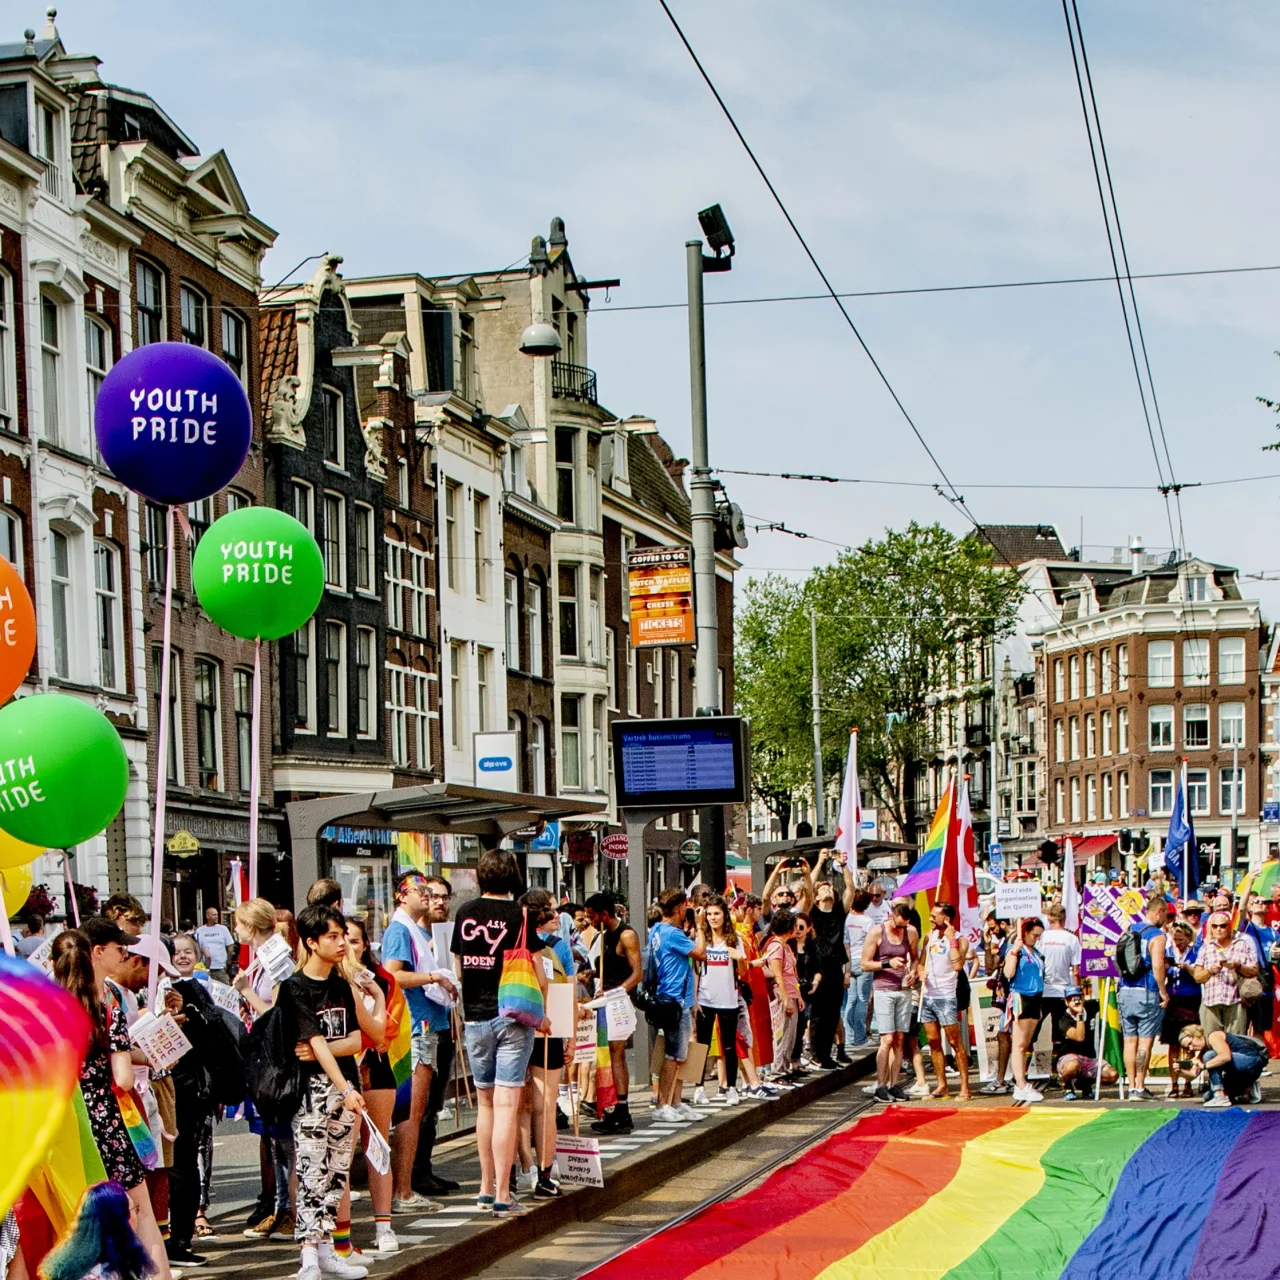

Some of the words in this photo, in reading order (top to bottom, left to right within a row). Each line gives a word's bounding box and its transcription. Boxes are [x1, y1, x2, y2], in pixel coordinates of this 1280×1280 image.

[129, 387, 218, 415] YOUTH
[130, 416, 218, 445] PRIDE
[220, 540, 293, 561] YOUTH
[632, 554, 660, 564] COFFEE
[222, 563, 293, 585] PRIDE
[630, 579, 655, 588] DUTCH
[646, 601, 675, 609] CHEESE
[640, 618, 683, 630] TICKETS
[623, 733, 647, 742] Vertrek
[648, 732, 692, 740] bussen/trams
[1001, 886, 1032, 894] HIV/aids
[1091, 887, 1113, 911] OUR
[463, 955, 496, 966] DOEN
